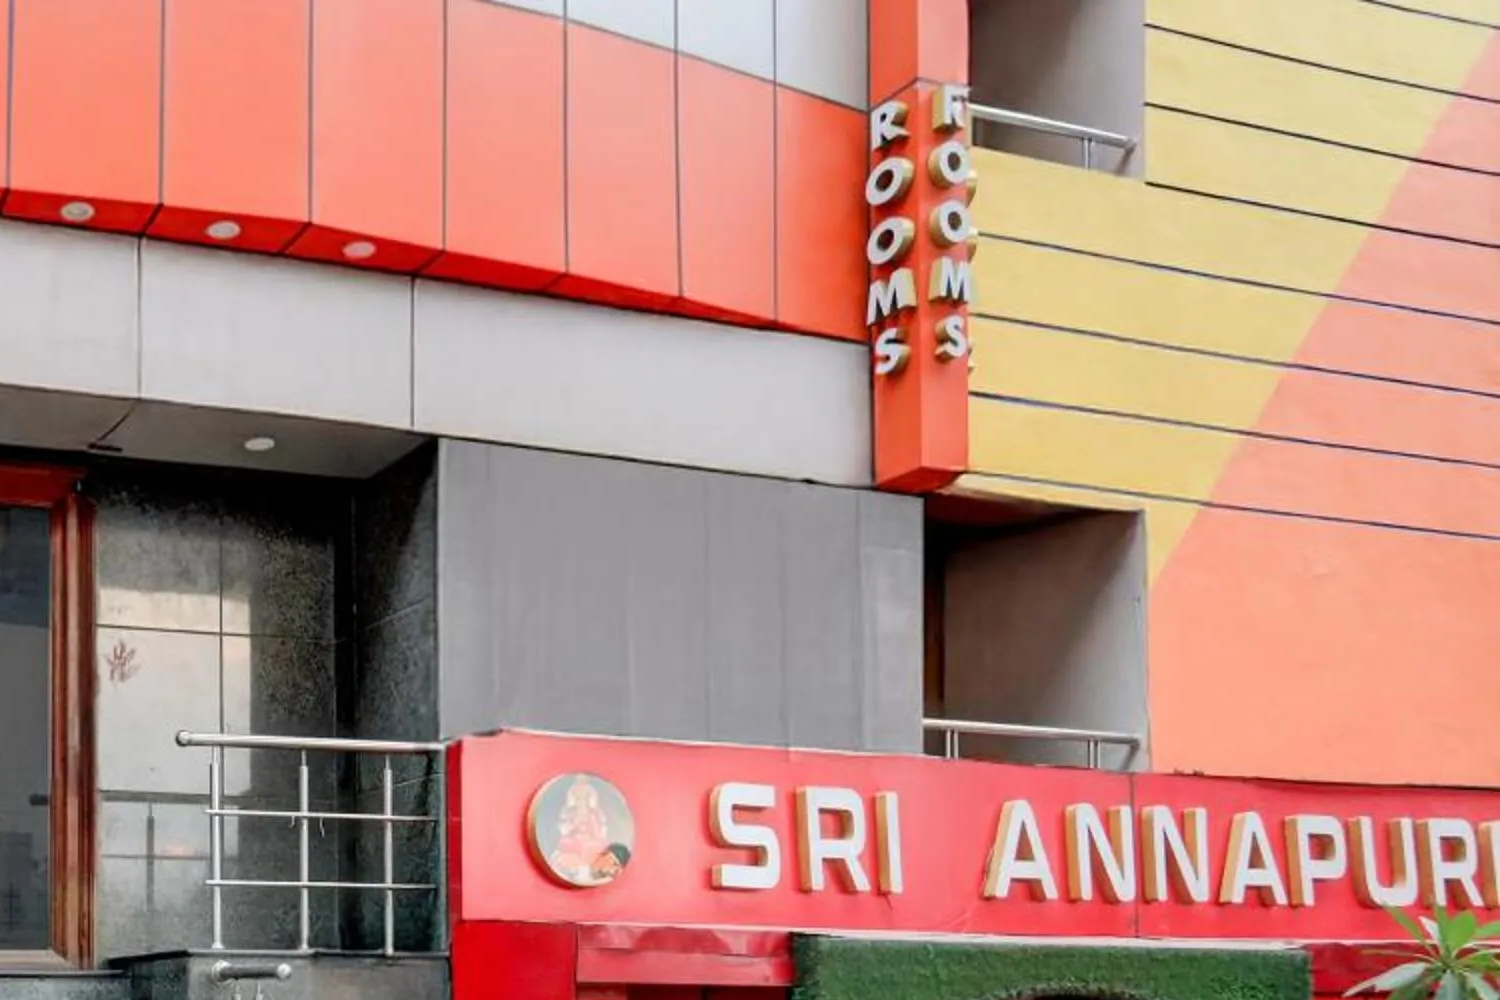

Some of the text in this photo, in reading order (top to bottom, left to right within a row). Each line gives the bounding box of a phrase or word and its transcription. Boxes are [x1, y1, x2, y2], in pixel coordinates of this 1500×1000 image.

[865, 99, 917, 377] ROOMS
[928, 84, 972, 362] ROOMS
[709, 782, 1500, 910] SRI ANNAPUR
